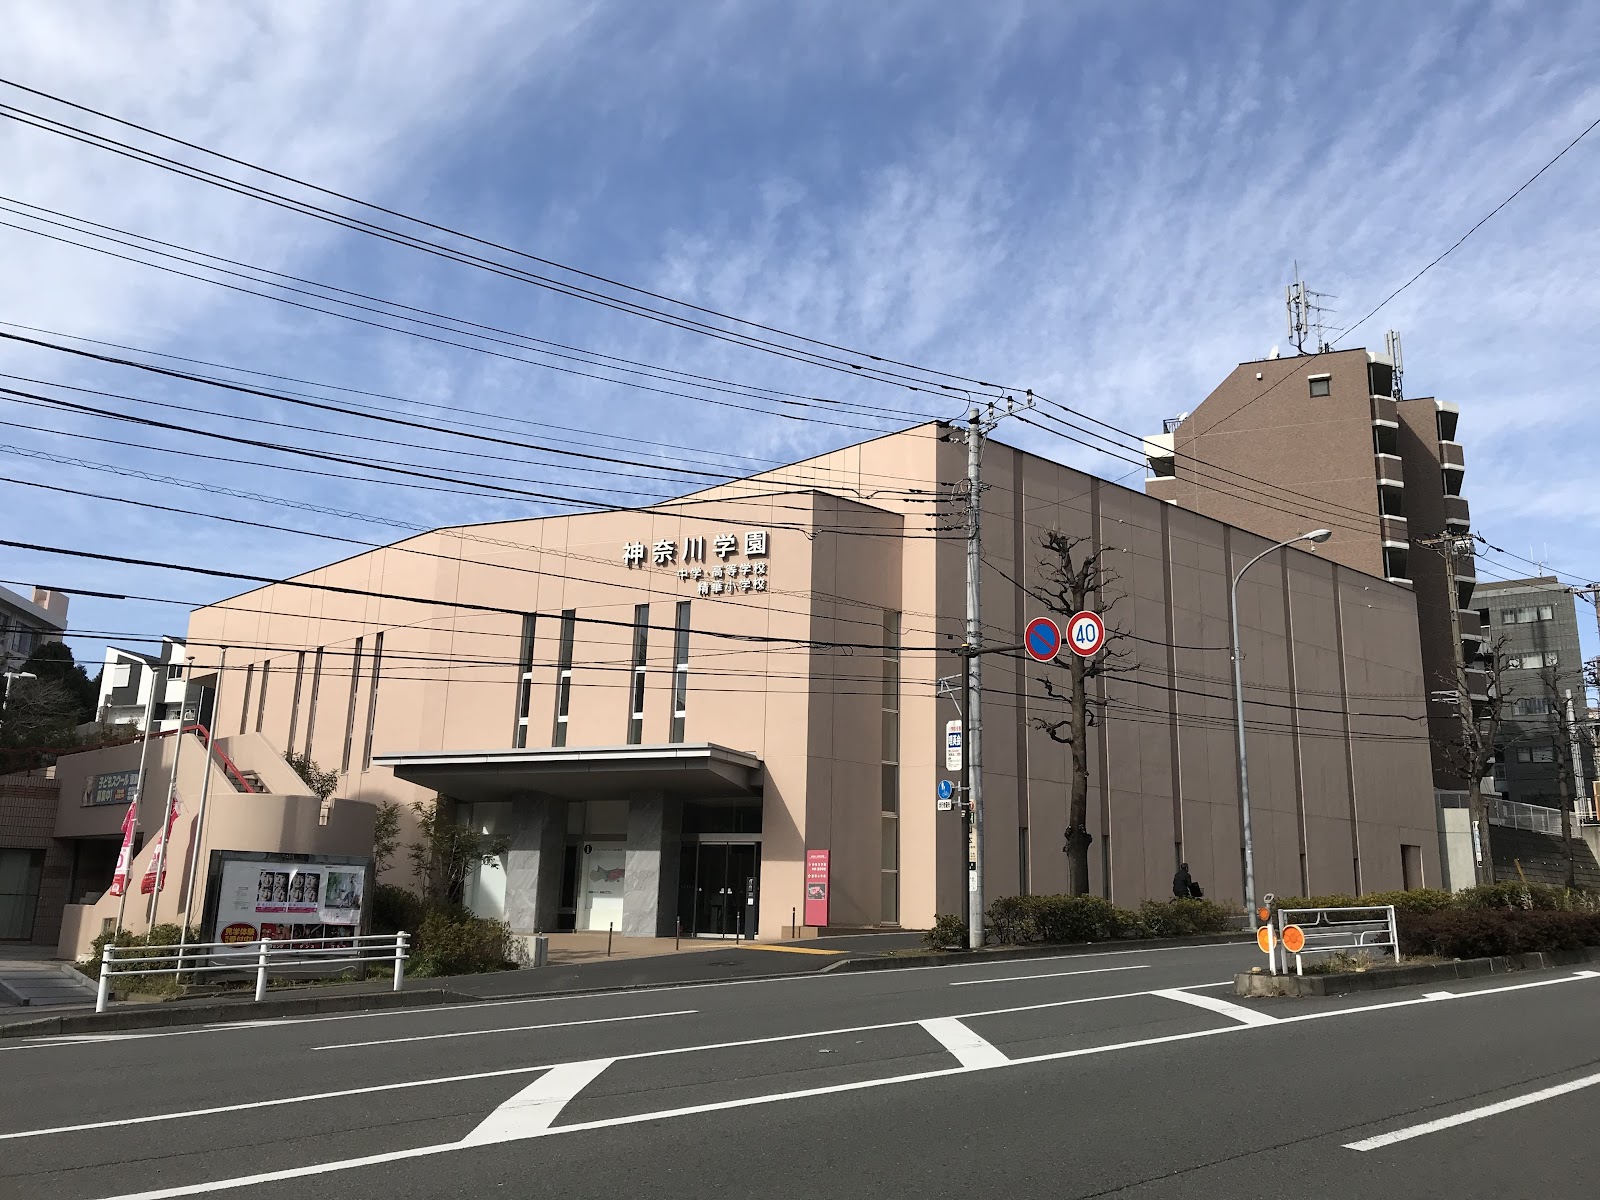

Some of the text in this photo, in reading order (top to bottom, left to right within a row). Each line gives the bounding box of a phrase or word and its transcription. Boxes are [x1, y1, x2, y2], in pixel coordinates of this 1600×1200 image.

[622, 530, 768, 566] 神奈川学園
[677, 561, 767, 580] 中学・高等学校
[697, 577, 767, 596] 精華小学校
[1075, 623, 1096, 644] 40
[224, 927, 255, 936] 見学体験
